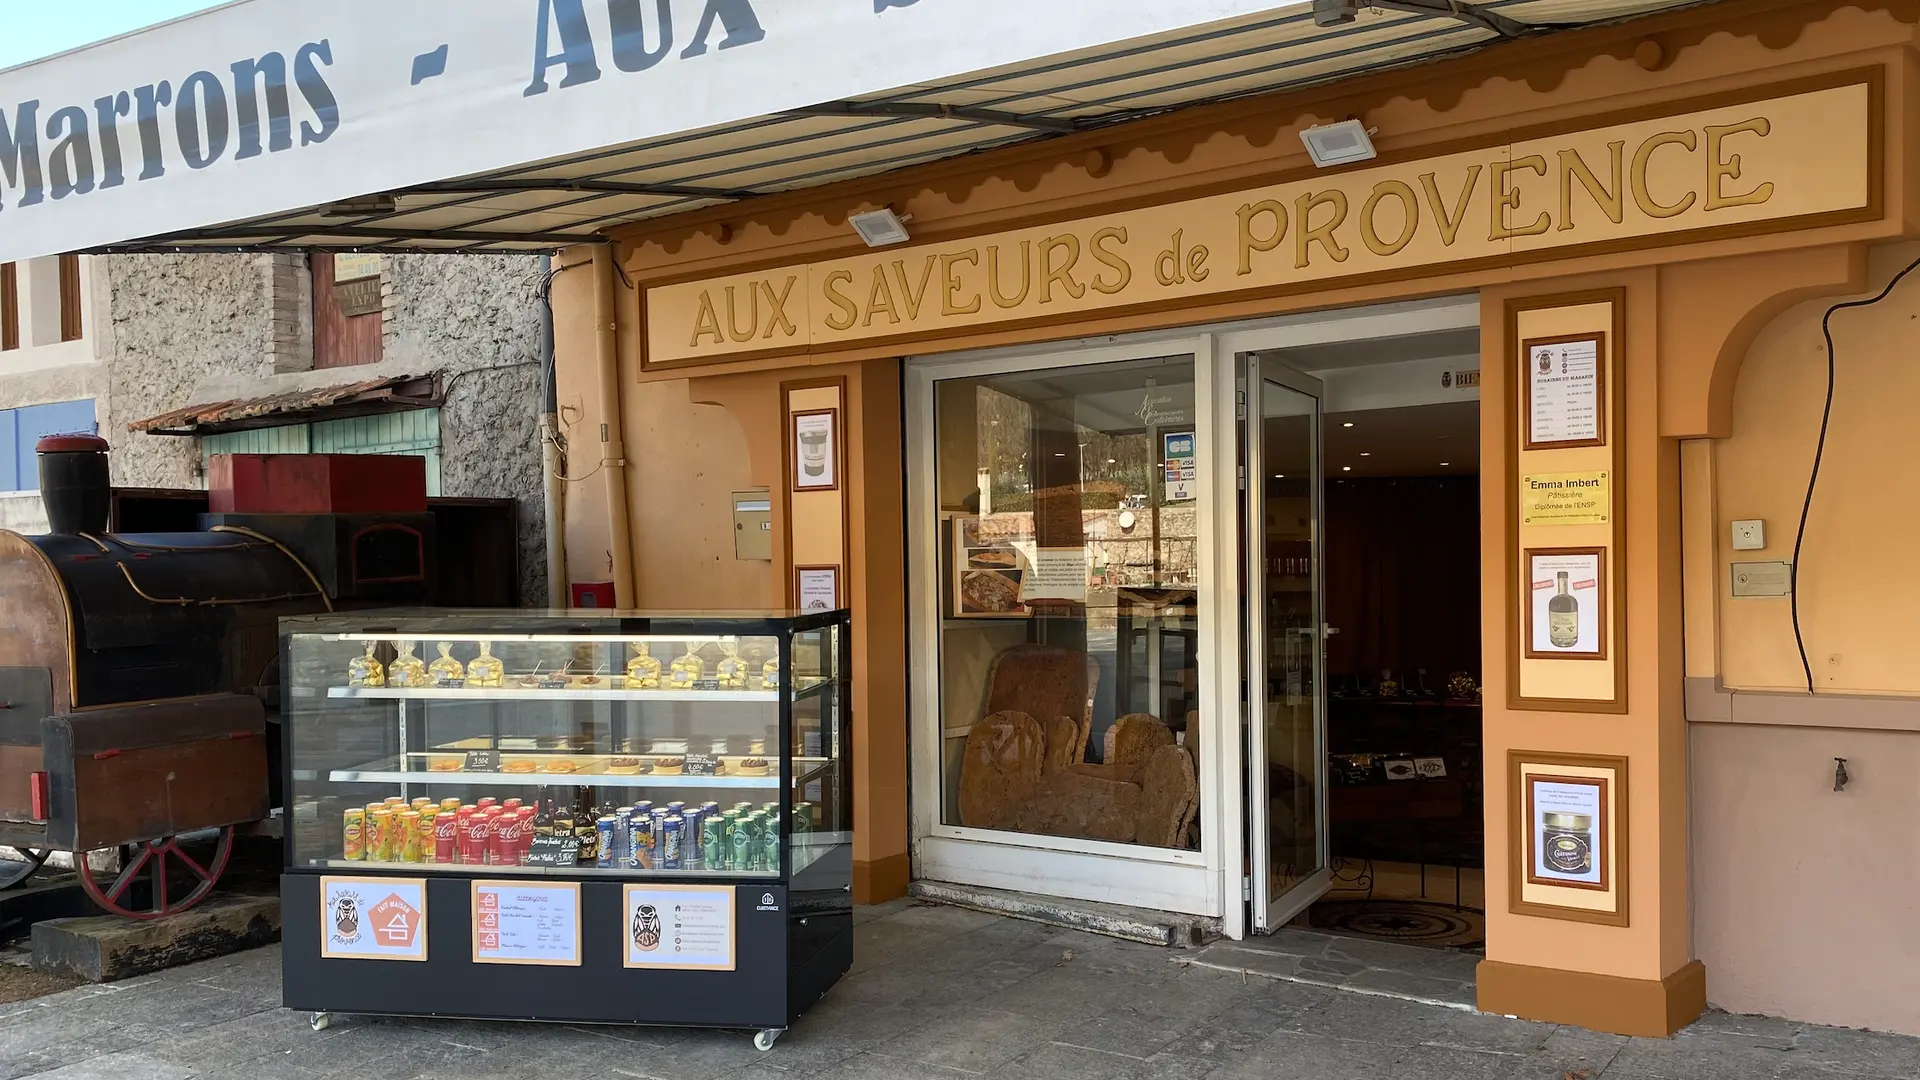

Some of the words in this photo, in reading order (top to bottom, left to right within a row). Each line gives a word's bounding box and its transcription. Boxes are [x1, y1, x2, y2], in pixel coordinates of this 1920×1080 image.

[689, 275, 797, 347] AUX
[824, 226, 1132, 330] SAVEURS
[1155, 228, 1210, 286] de
[1236, 116, 1774, 276] PROVENCE
[1531, 481, 1562, 489] Emma
[1566, 479, 1599, 488] Imbert
[377, 901, 389, 914] FAIT
[390, 900, 411, 914] MAISON
[637, 932, 656, 946] ASP
